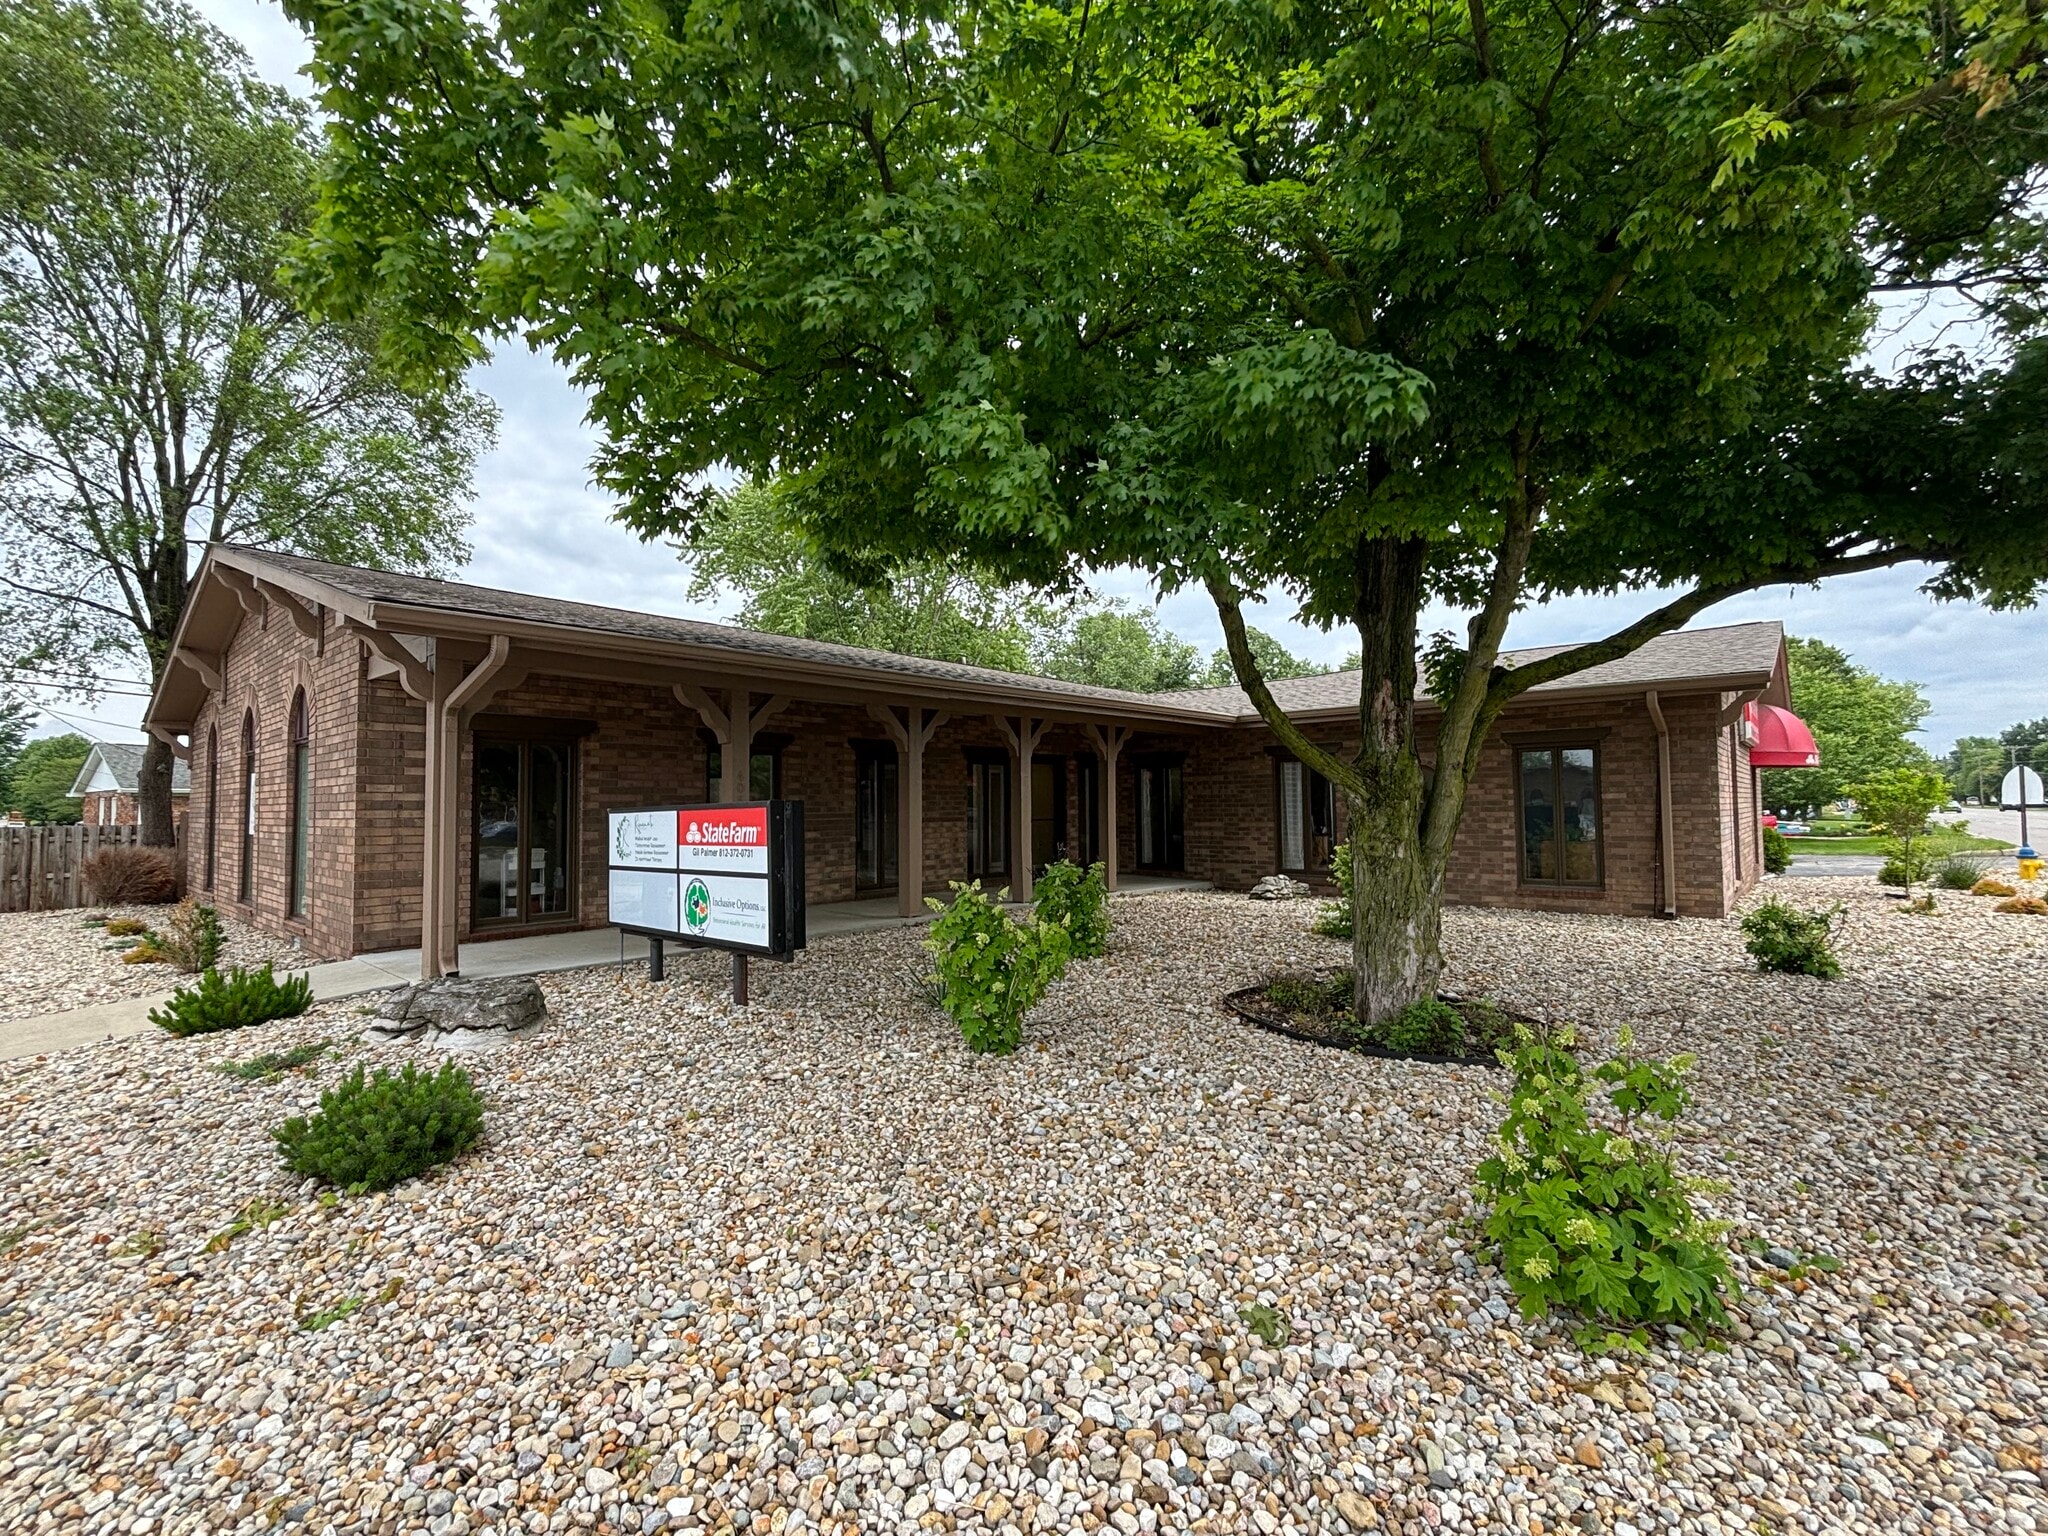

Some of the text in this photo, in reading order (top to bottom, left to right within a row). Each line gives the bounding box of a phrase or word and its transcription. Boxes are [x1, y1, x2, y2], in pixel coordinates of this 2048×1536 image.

[692, 848, 754, 858] Gil Palmer 812-372-0731
[712, 896, 736, 909] Inclusive
[736, 898, 760, 912] Options
